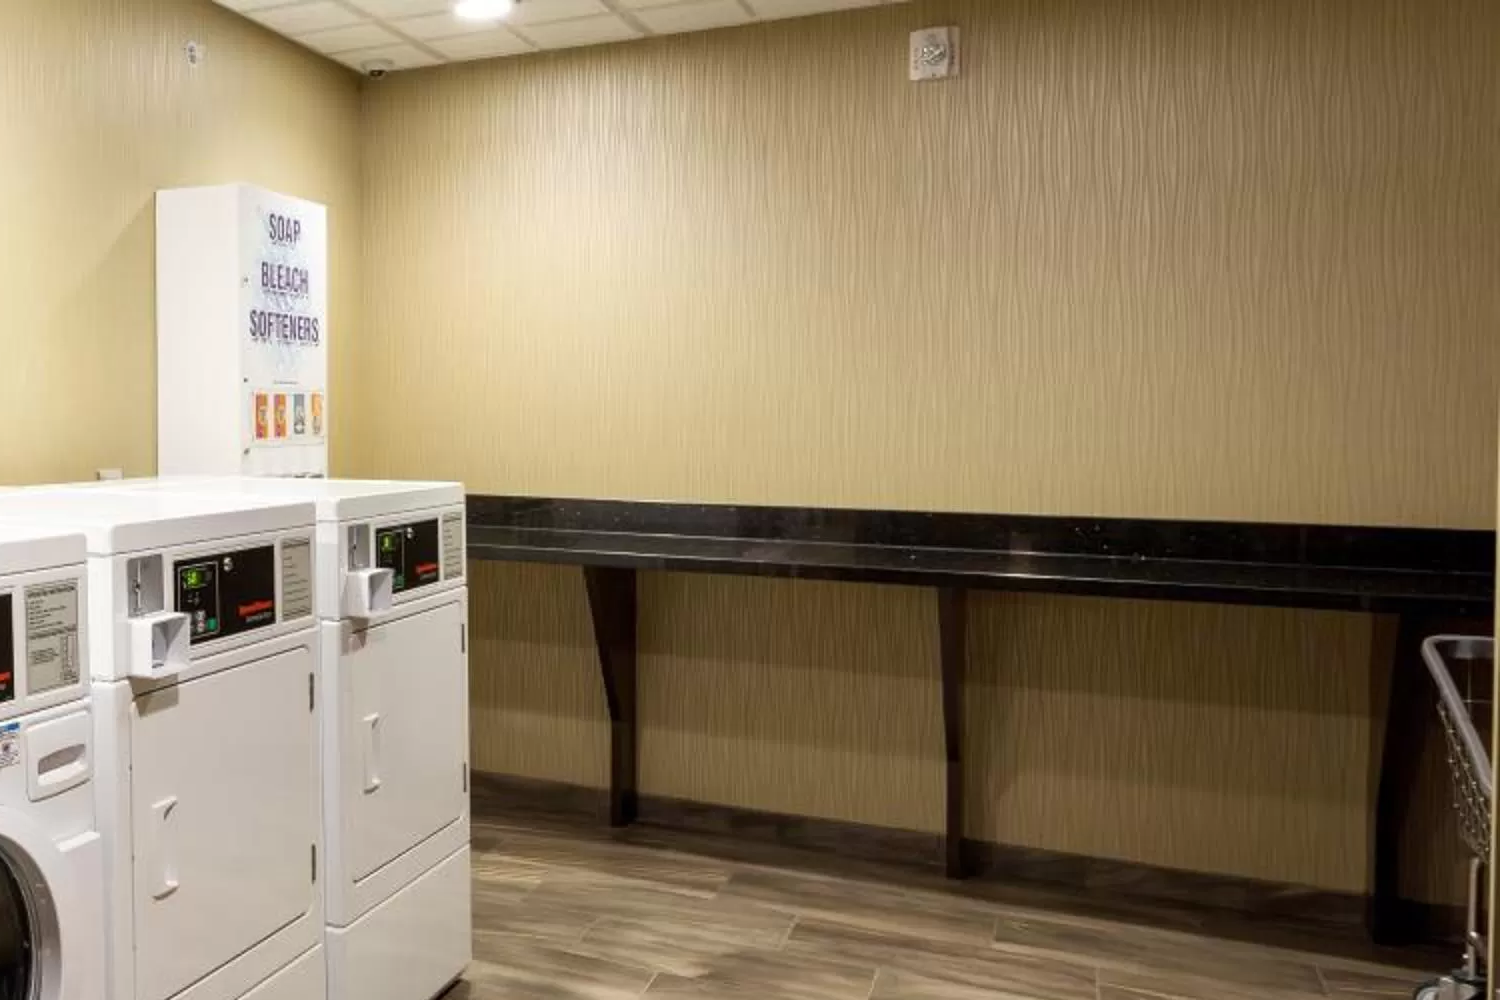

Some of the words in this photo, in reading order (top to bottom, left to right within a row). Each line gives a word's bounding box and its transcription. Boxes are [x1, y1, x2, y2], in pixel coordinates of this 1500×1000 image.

[269, 213, 300, 243] SOAP
[261, 261, 309, 294] BLEACH
[250, 309, 319, 343] SOFTENERS
